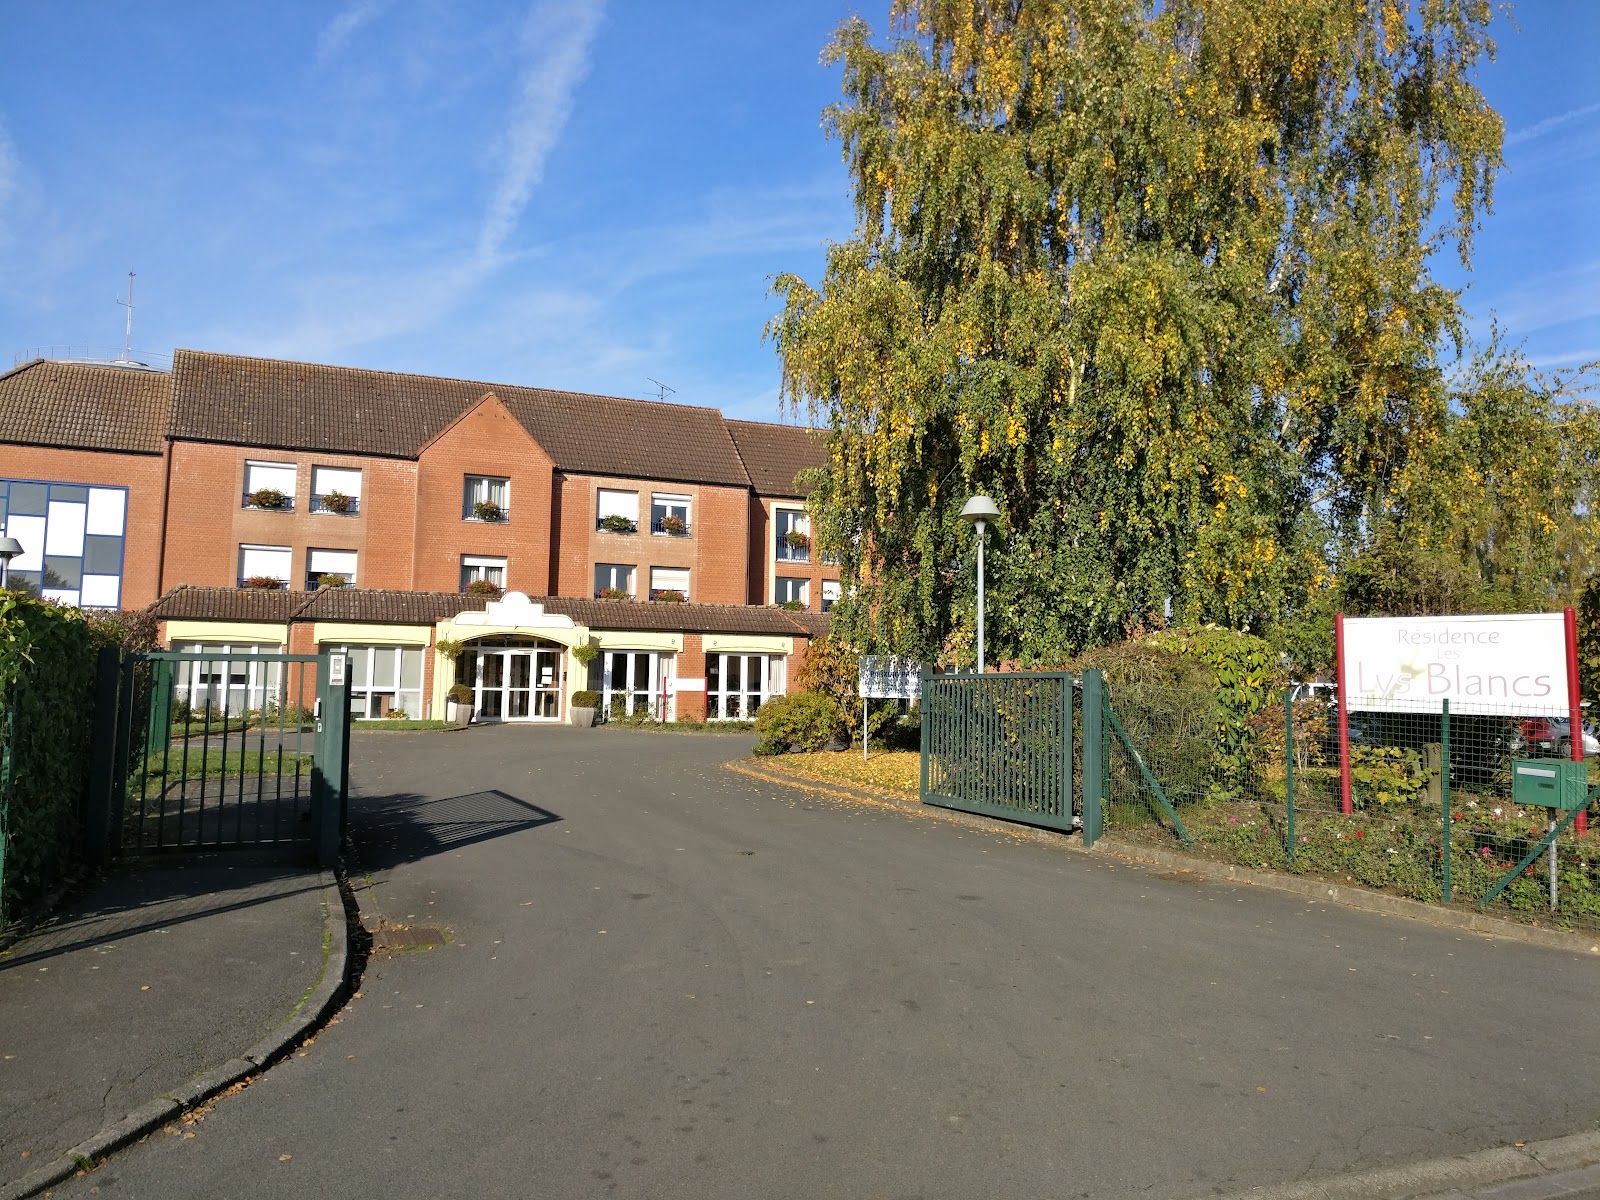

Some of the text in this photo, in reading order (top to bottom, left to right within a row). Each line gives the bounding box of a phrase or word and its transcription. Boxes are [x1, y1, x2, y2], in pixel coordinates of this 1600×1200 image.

[1398, 626, 1500, 645] Résidence
[1437, 648, 1461, 660] Les
[1358, 660, 1552, 701] Lys Blancs
